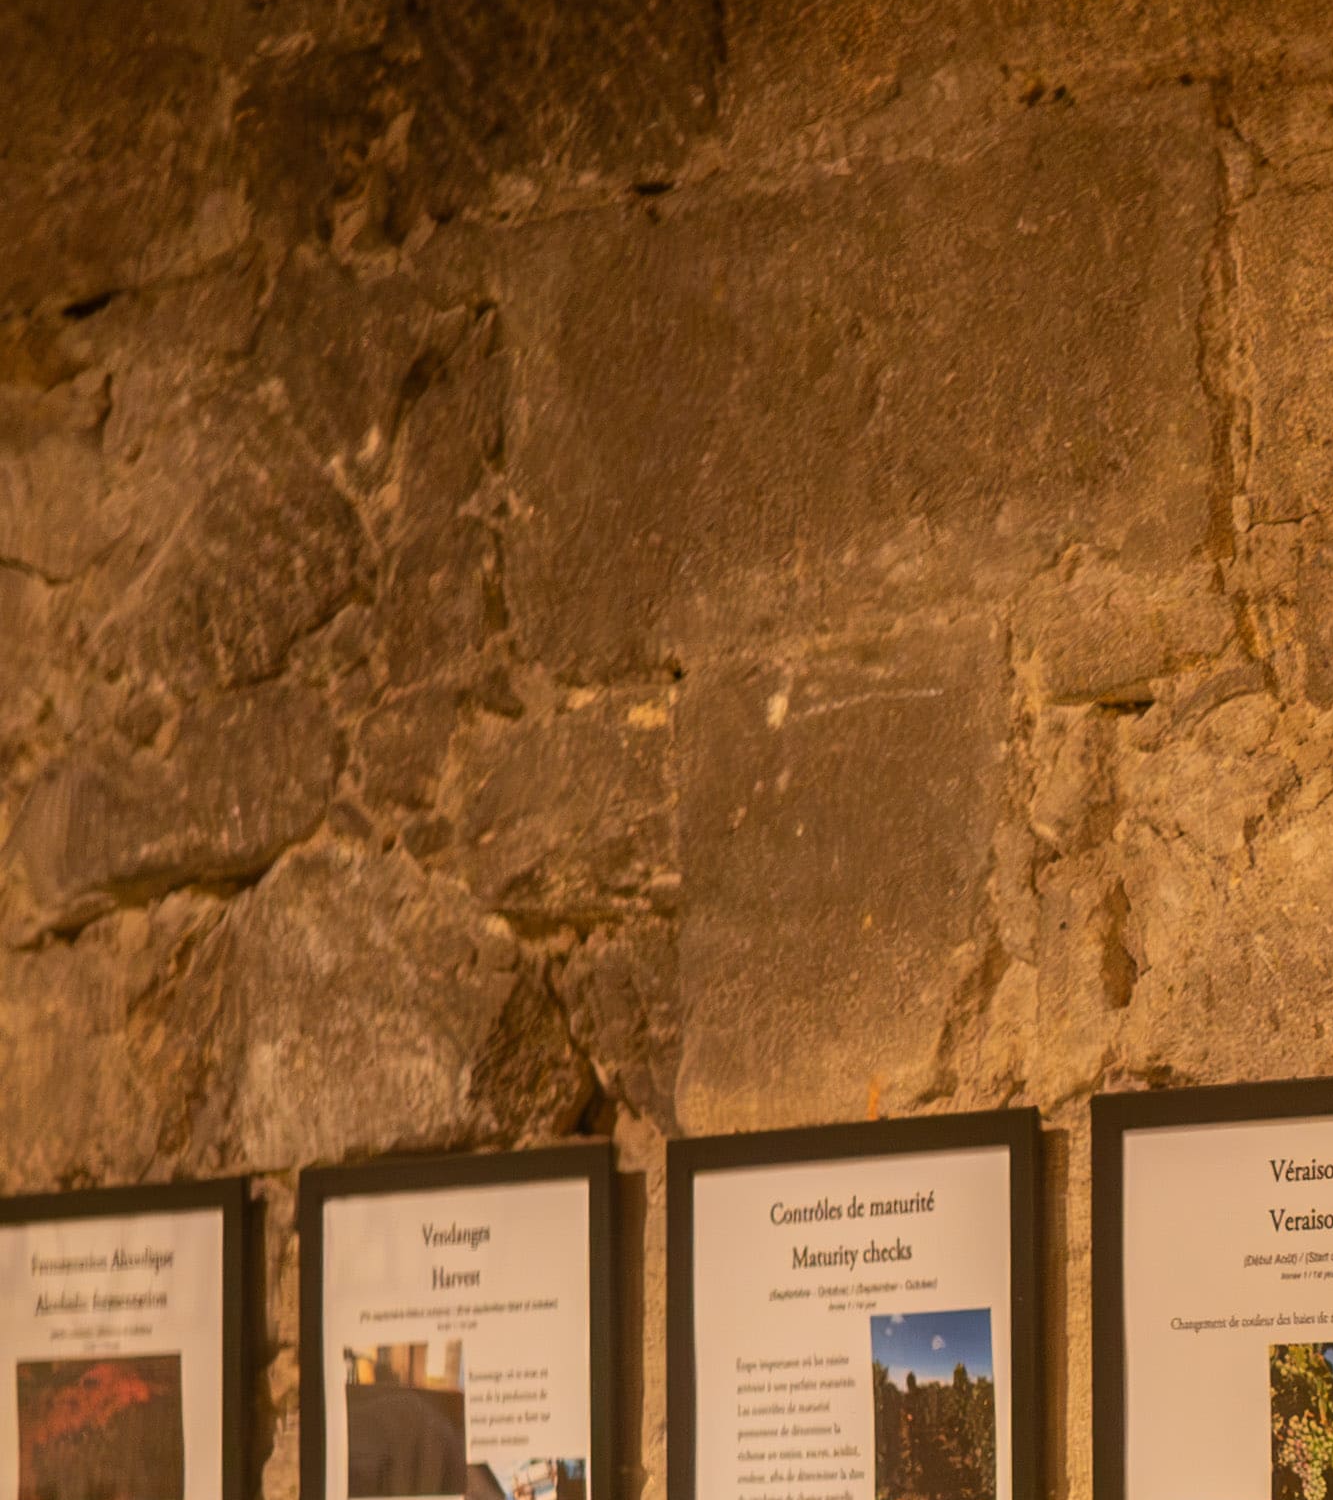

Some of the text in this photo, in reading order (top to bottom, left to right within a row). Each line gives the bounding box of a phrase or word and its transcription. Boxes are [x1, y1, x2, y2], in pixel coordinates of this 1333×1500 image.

[770, 1190, 934, 1225] Contrôles de maturité
[422, 1222, 490, 1249] Vendanges
[792, 1237, 912, 1271] Maturity checks
[432, 1266, 479, 1290] Harvest
